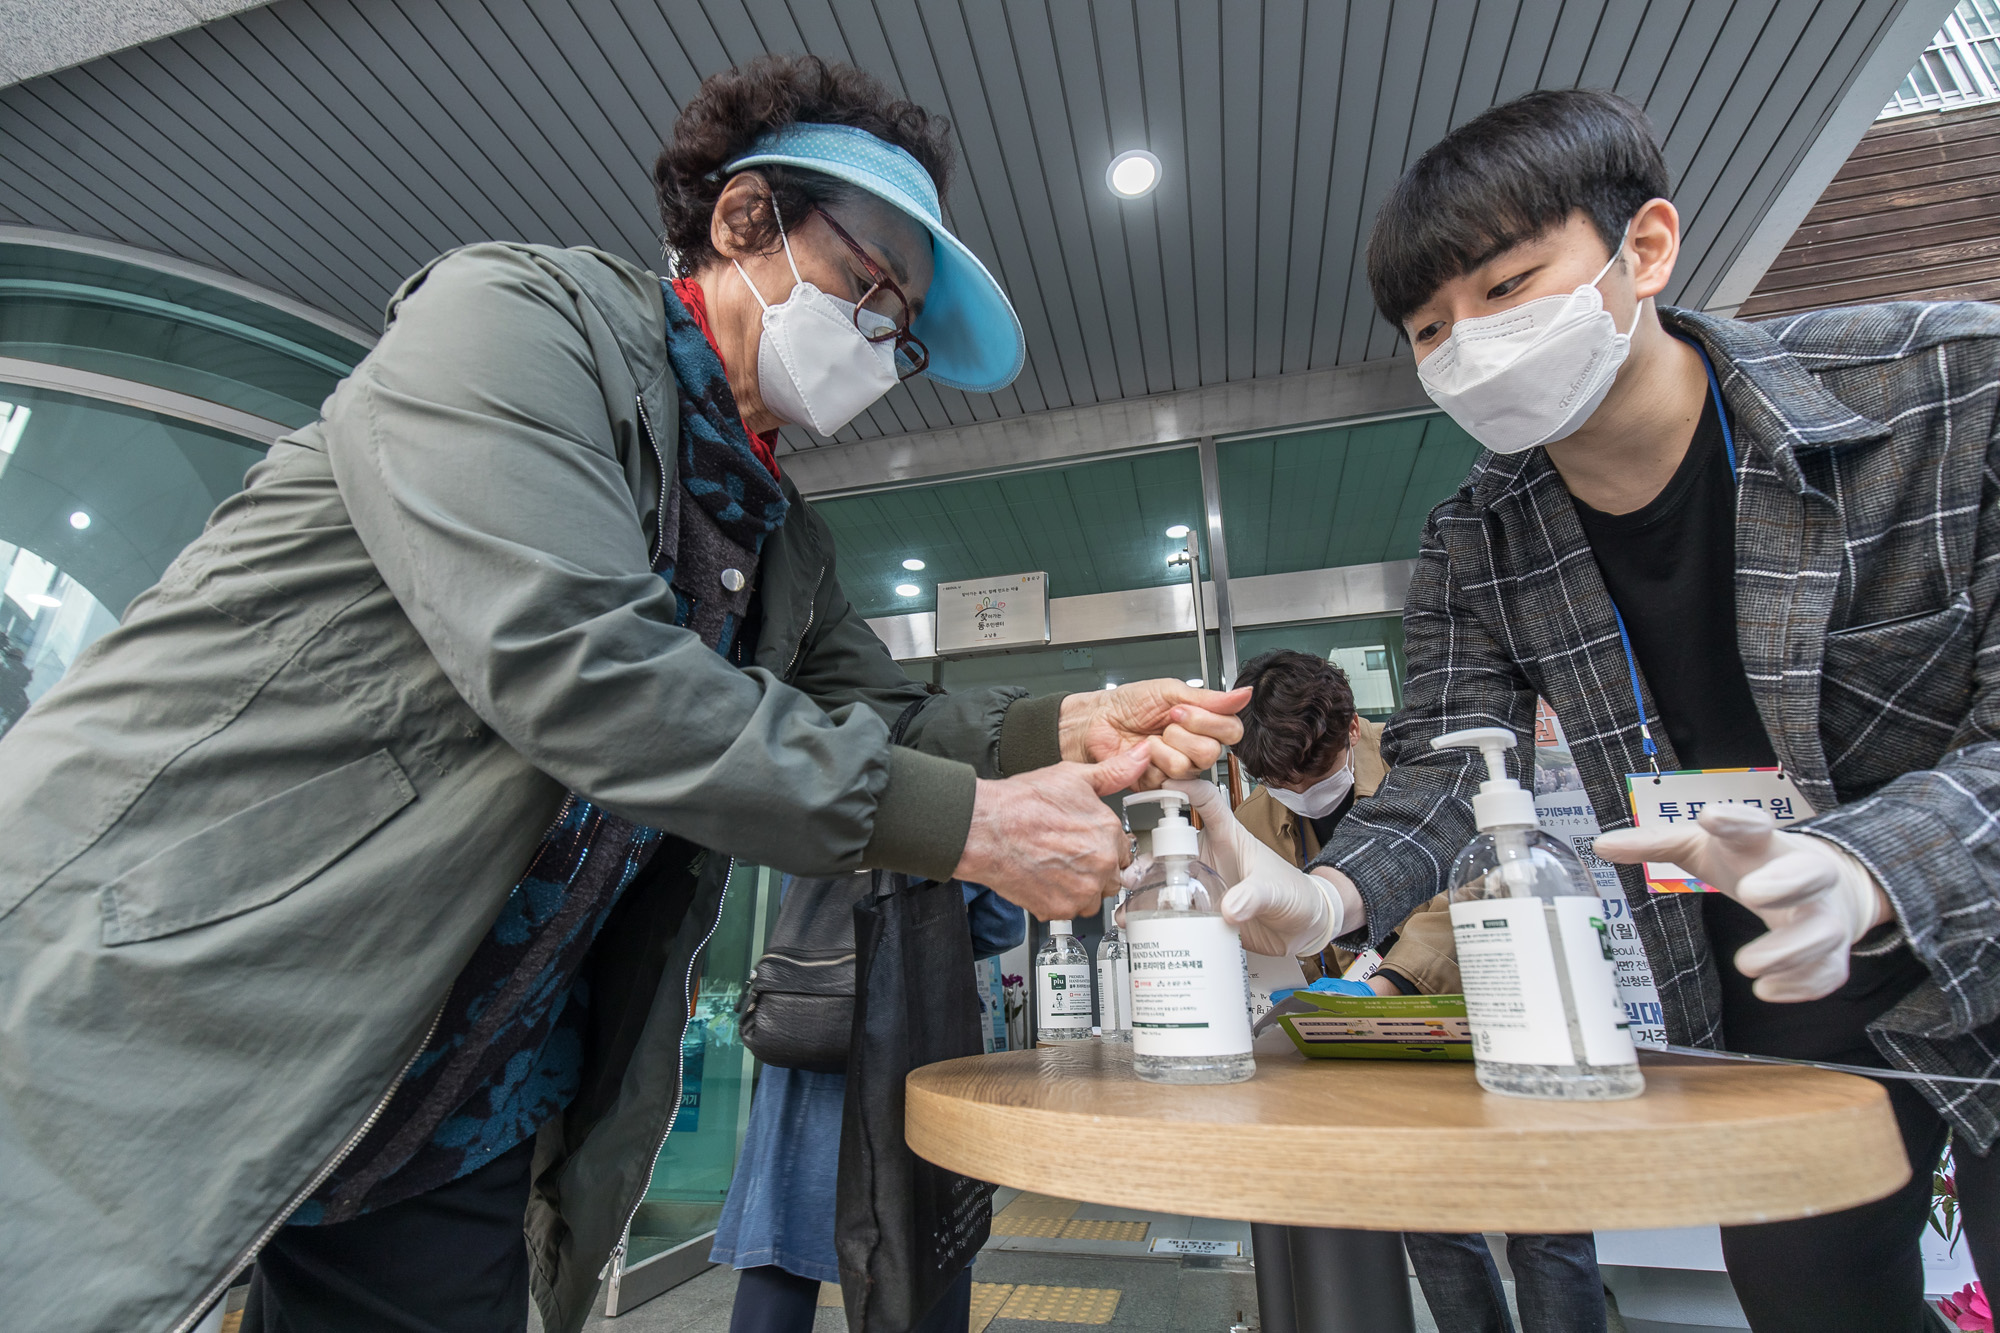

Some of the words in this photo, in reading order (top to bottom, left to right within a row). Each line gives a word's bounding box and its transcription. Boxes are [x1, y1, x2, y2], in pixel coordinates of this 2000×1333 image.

[1659, 797, 1795, 823] 투표원
[1132, 941, 1160, 950] PREMIUM
[1148, 949, 1191, 959] SANITIZER
[1142, 961, 1166, 970] 프리미엄
[1167, 960, 1204, 970] 손소독제겔
